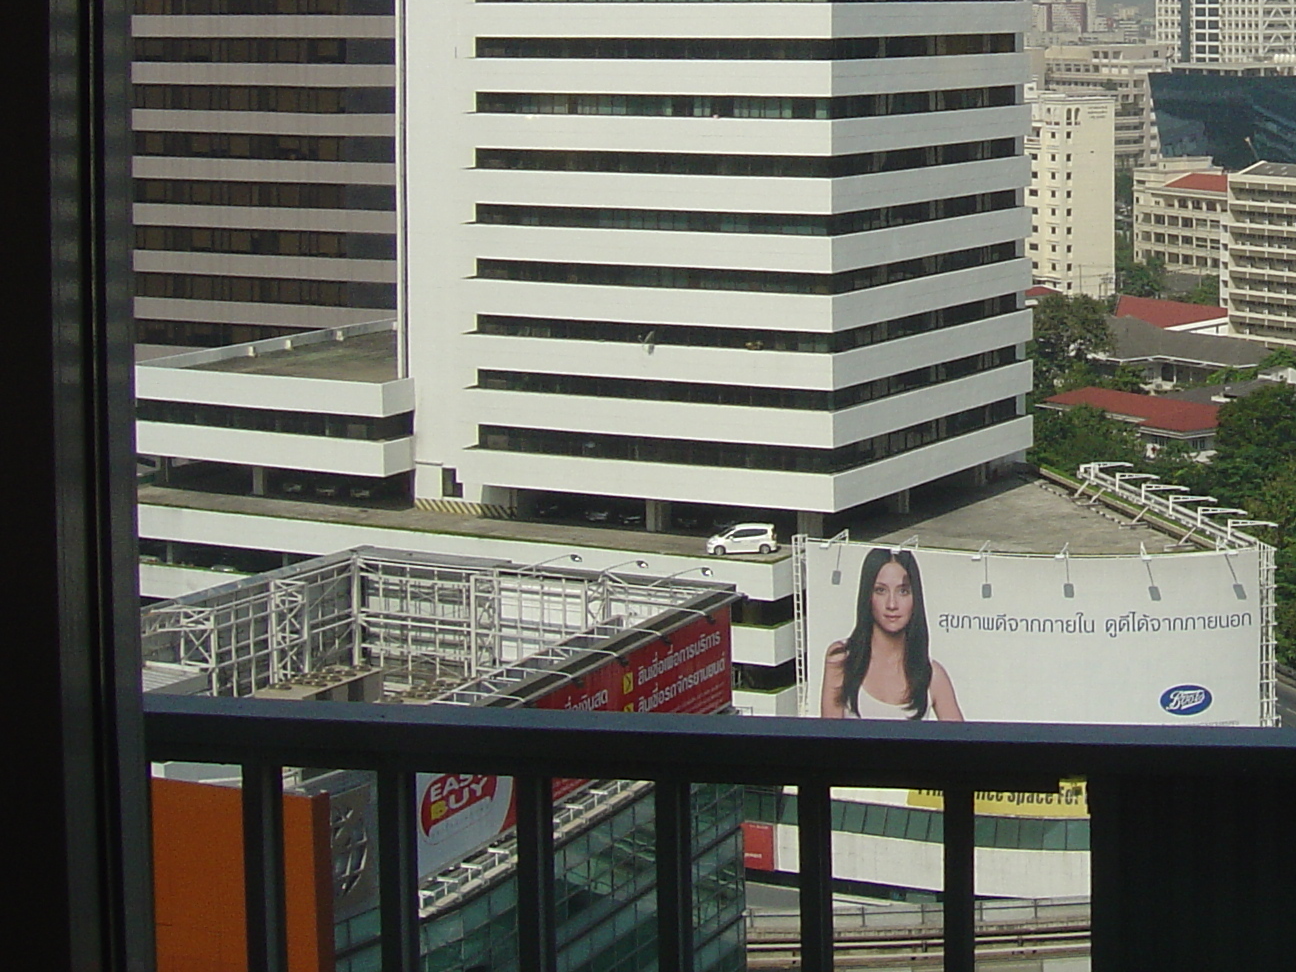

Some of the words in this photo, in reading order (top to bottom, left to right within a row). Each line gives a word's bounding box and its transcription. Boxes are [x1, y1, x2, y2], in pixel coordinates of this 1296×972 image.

[938, 611, 1095, 634] สุขภาพดีจากภายใน
[1105, 610, 1252, 638] ดูดีได้จากภายนอก
[1166, 690, 1205, 710] Boots
[430, 775, 484, 802] EAS
[430, 776, 488, 820] BUY
